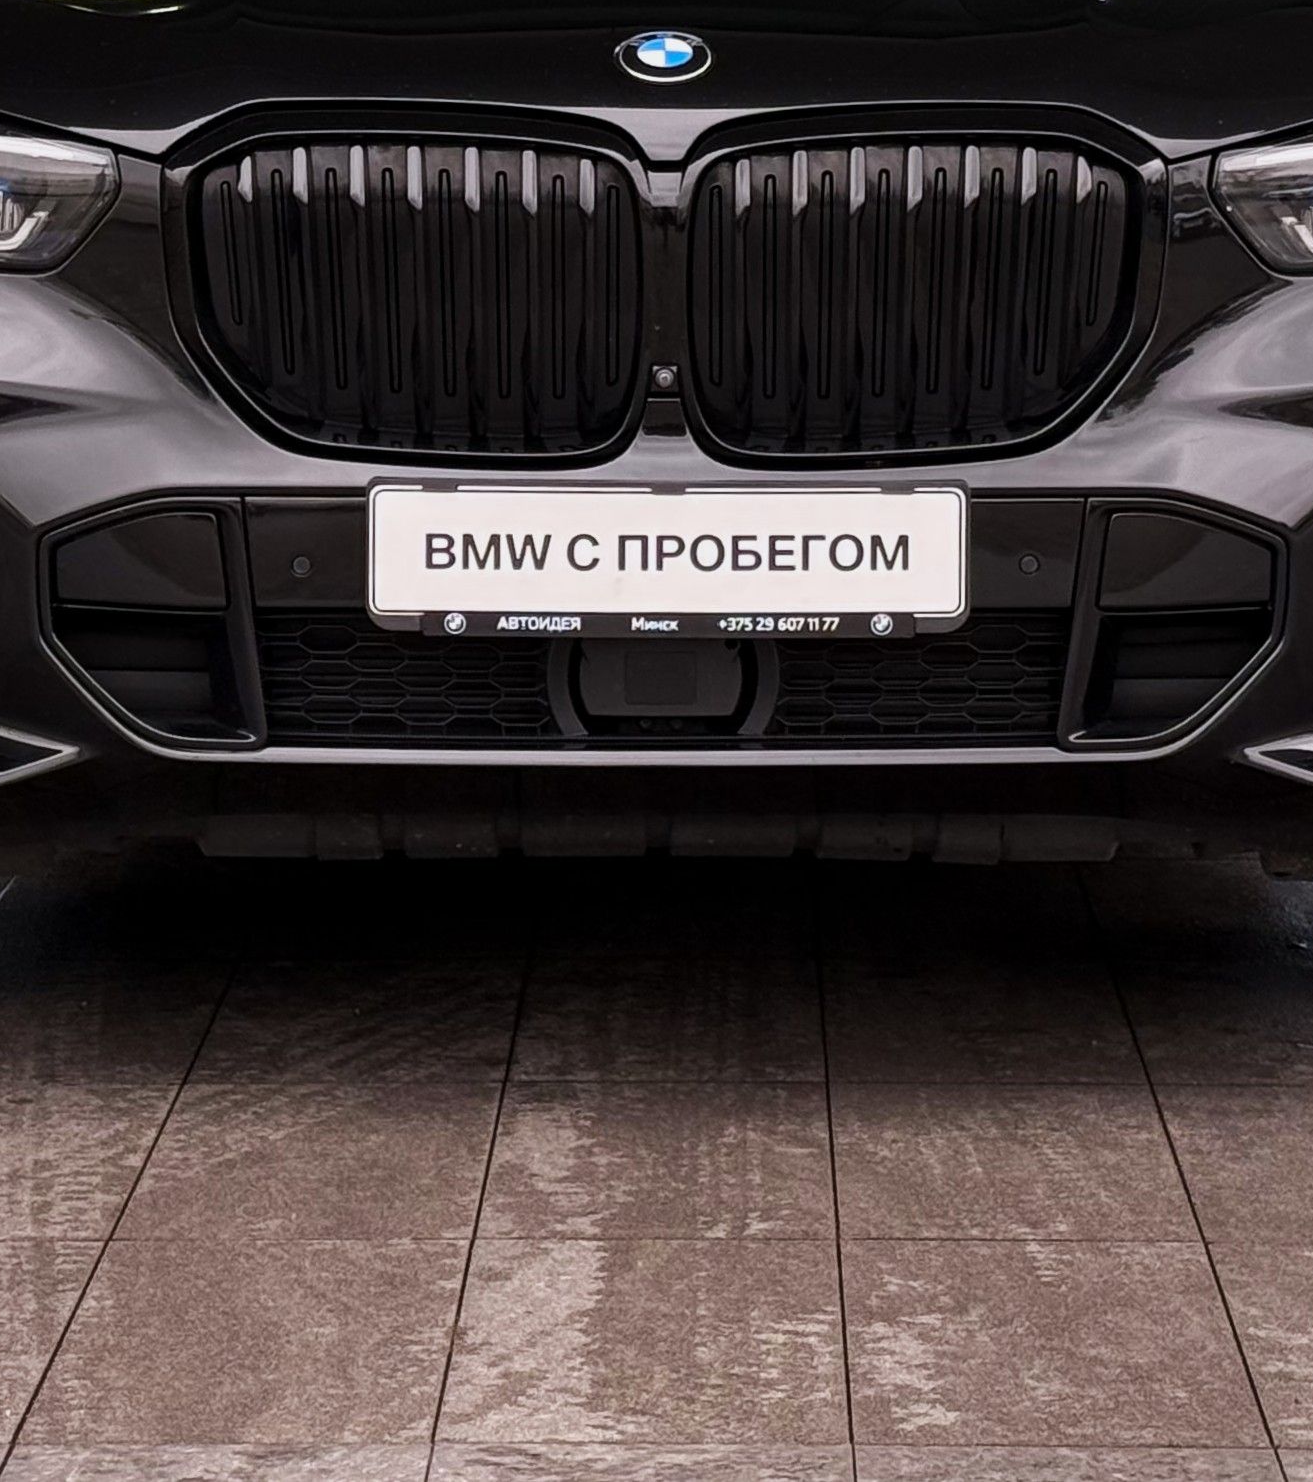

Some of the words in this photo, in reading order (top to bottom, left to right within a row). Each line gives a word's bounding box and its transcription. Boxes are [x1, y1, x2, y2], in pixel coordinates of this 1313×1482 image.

[425, 533, 552, 570] BMW
[566, 533, 600, 571] С
[617, 534, 910, 572] ПРОБЕГОМ
[496, 615, 582, 632] АВТОИДЕЯ
[631, 616, 679, 632] Минск
[717, 616, 754, 632] +375
[755, 616, 775, 632] 29
[777, 616, 805, 632] 607
[806, 616, 820, 632] 11
[821, 616, 840, 632] 77
